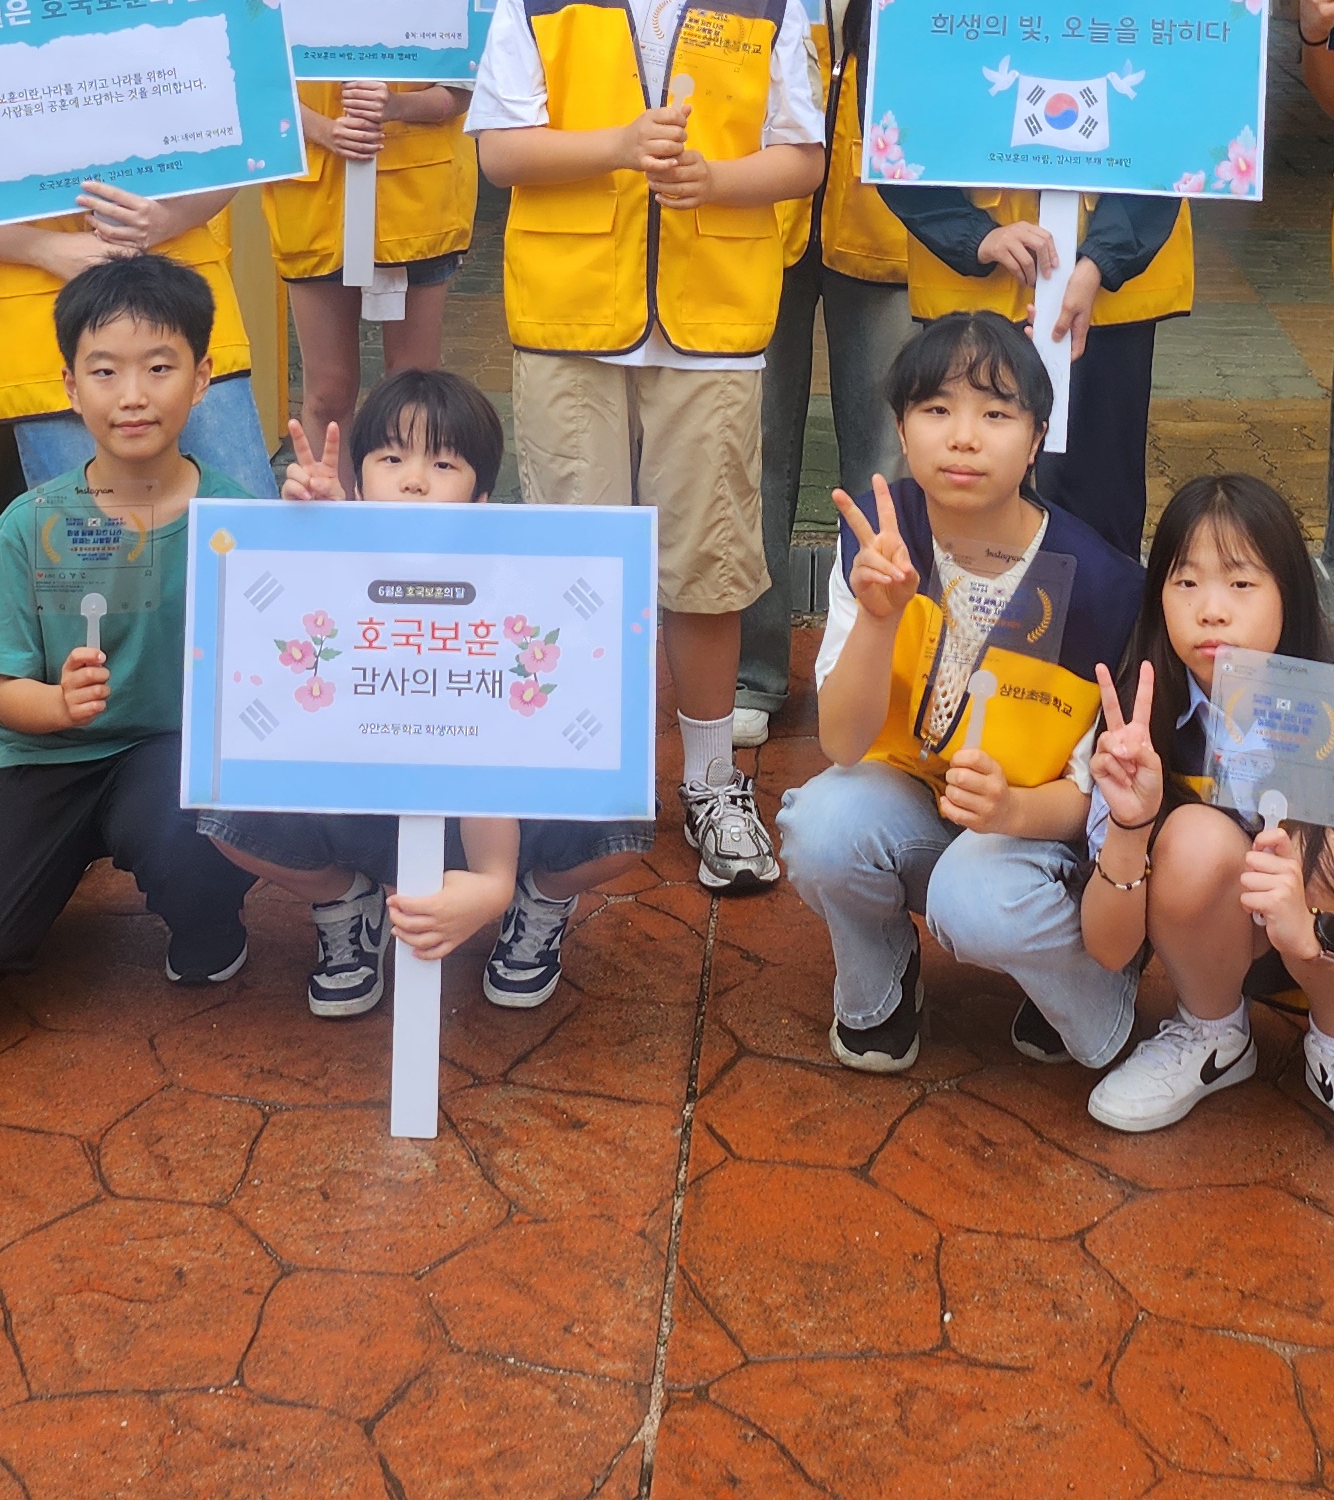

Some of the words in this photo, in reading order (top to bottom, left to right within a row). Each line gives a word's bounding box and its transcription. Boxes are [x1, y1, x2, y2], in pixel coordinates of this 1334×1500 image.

[930, 12, 1009, 41] 희생의
[1018, 14, 1051, 43] 빛,
[1061, 15, 1140, 45] 오늘을
[1150, 17, 1232, 45] 밝히다
[77, 77, 109, 92] 지키고
[112, 72, 144, 88] 나라를
[1, 102, 45, 120] 사람들의
[47, 96, 80, 113] 공훈에
[82, 91, 124, 107] 보답하는
[128, 86, 148, 100] 것을
[151, 78, 208, 97] 의미합니다.
[74, 486, 115, 497] Instagram
[985, 548, 1027, 563] Instagram
[378, 585, 404, 597] 6월은
[405, 586, 454, 598] 호국보훈의
[455, 587, 465, 599] 달
[353, 617, 499, 657] 호국보훈
[351, 666, 437, 697] 감사의
[445, 668, 503, 699] 부채
[1000, 683, 1073, 717] 상안초등학교
[358, 722, 422, 735] 상안초등학교
